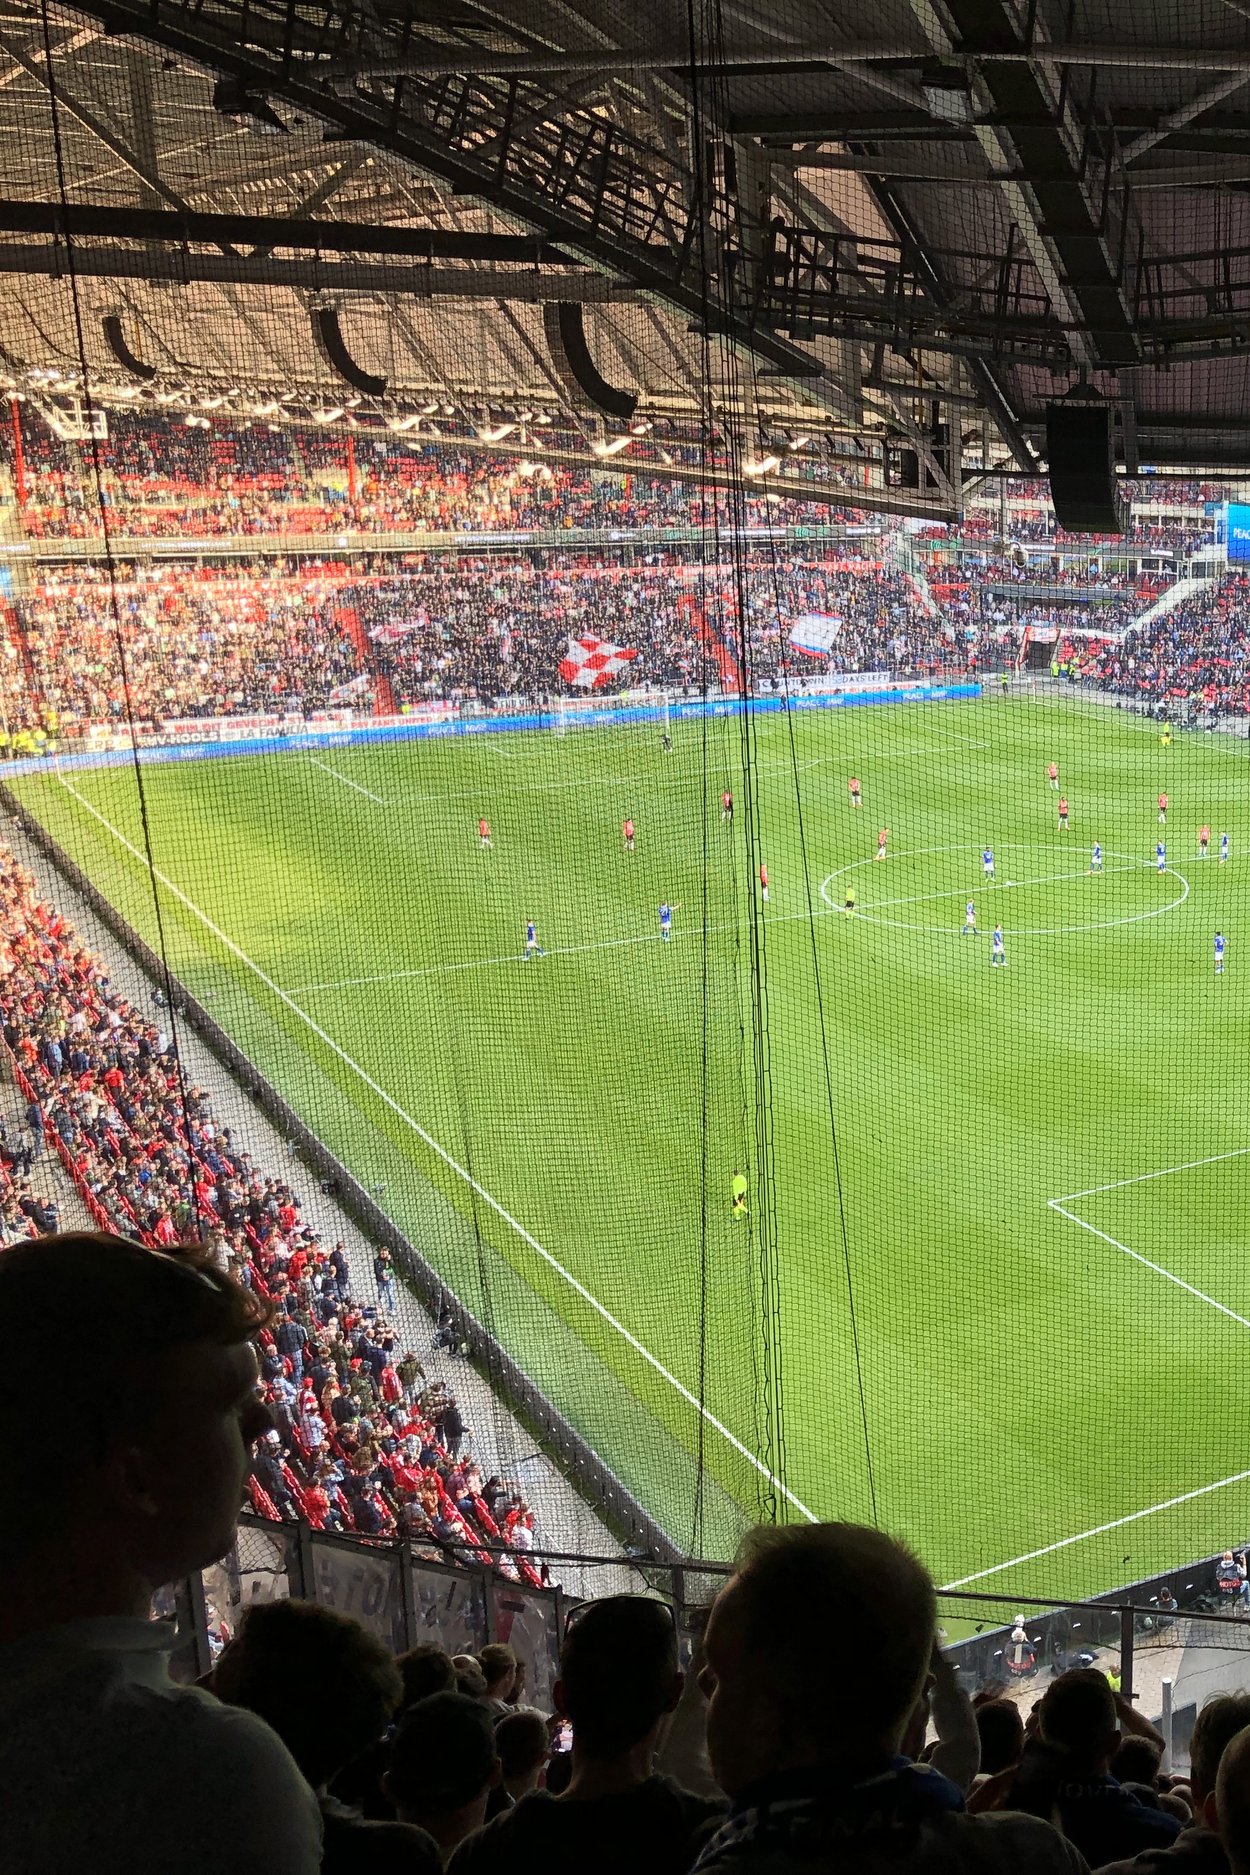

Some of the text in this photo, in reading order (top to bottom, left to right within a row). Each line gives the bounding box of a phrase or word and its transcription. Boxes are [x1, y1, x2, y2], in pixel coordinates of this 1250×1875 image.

[762, 676, 825, 688] CUNTDWN
[843, 674, 866, 683] DAYS
[868, 673, 888, 682] LEFT
[240, 728, 255, 738] LA
